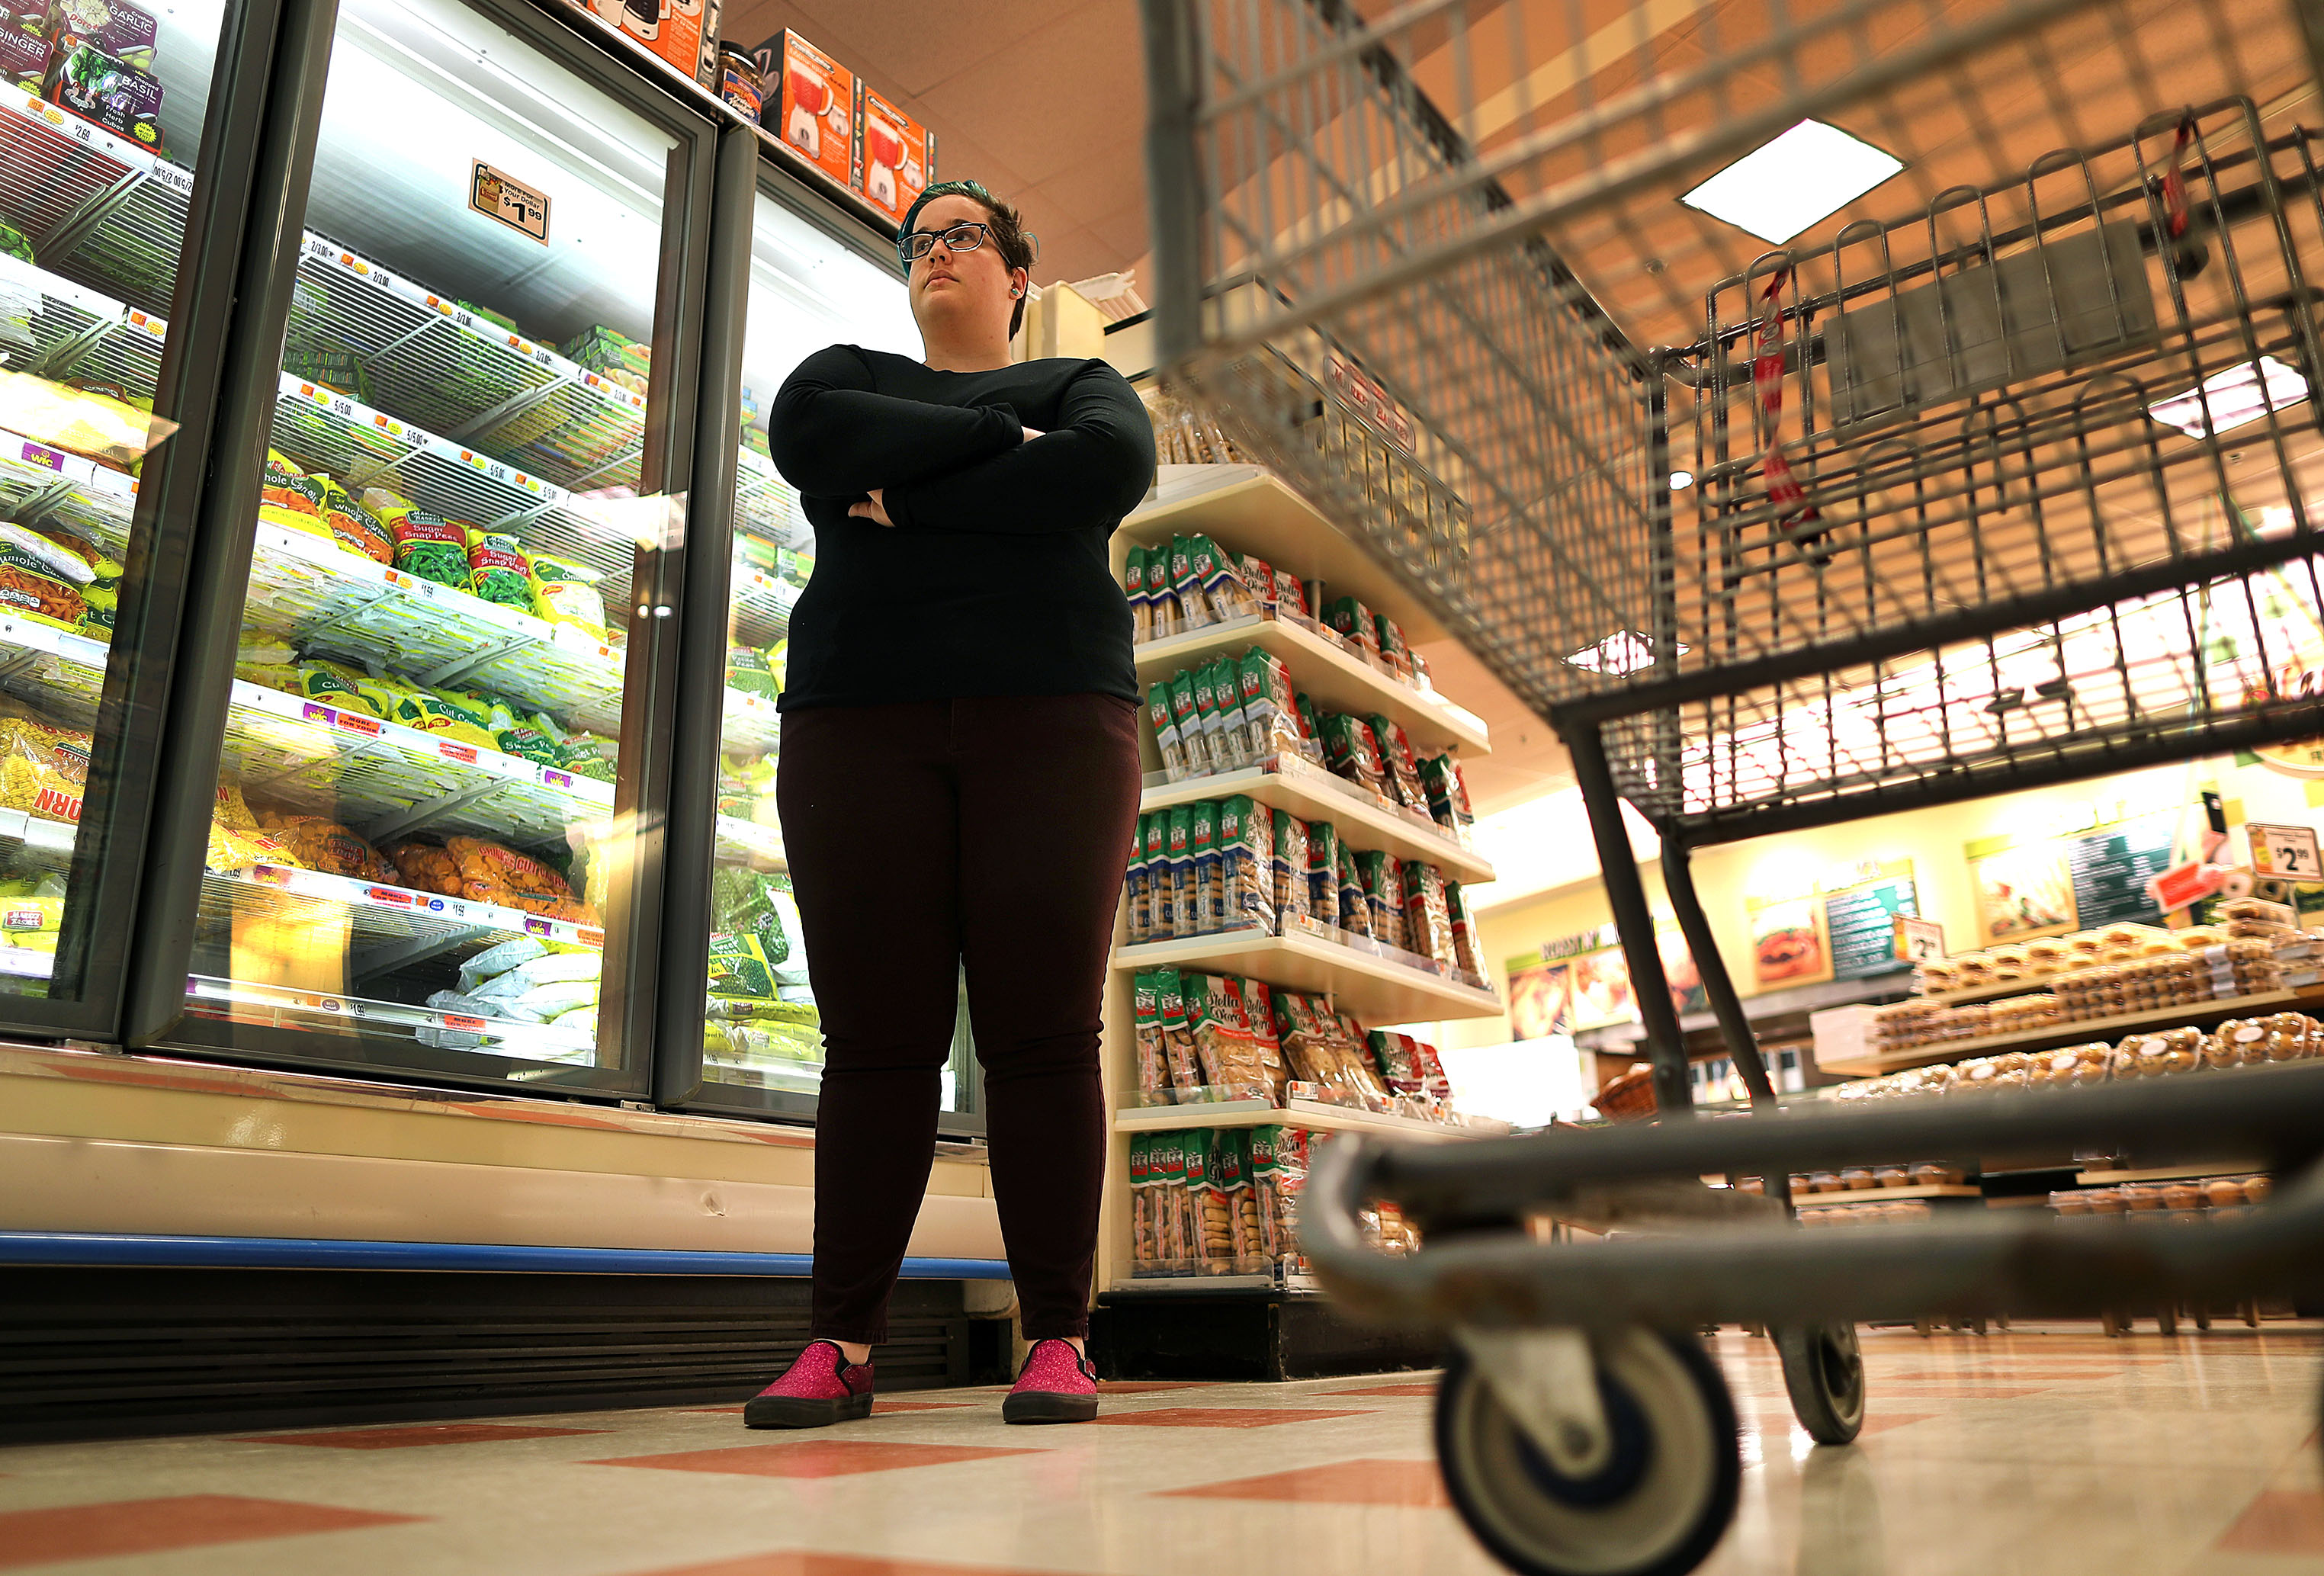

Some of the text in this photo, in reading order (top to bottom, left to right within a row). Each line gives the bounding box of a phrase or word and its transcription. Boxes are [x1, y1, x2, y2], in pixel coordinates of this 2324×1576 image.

[109, 6, 152, 33] GARLIC
[131, 11, 154, 24] Crushed
[21, 33, 47, 49] Crushed
[121, 75, 156, 100] BASIL
[134, 75, 159, 91] Chopped
[105, 104, 126, 118] Fresh
[105, 111, 124, 124] Herb
[101, 117, 124, 132] Cubes
[75, 124, 91, 142] $2.69
[154, 165, 173, 183] 2/5.00
[504, 187, 541, 210] Your Dollar
[334, 400, 351, 416] 5/5.00
[406, 430, 423, 445] 5/5.00
[30, 453, 53, 467] WIC
[264, 473, 318, 503] hole Carrots
[335, 503, 363, 521] Whole
[404, 530, 458, 542] Snap Peas
[413, 525, 443, 533] Sugar
[481, 557, 507, 567] Snap
[490, 550, 517, 563] Sugar
[1243, 563, 1269, 583] Stella
[1275, 577, 1300, 599] Stella
[309, 711, 328, 722] WIC
[438, 703, 455, 718] Cut
[348, 716, 371, 726] MORE
[356, 724, 377, 733] YOUR
[34, 787, 82, 822] ORN
[515, 856, 538, 876] CUT
[529, 925, 545, 935] WIC
[1205, 991, 1240, 1008] Stella
[1246, 996, 1268, 1015] Stella
[350, 1003, 366, 1017] $1.99
[1210, 1006, 1241, 1022] D'oro
